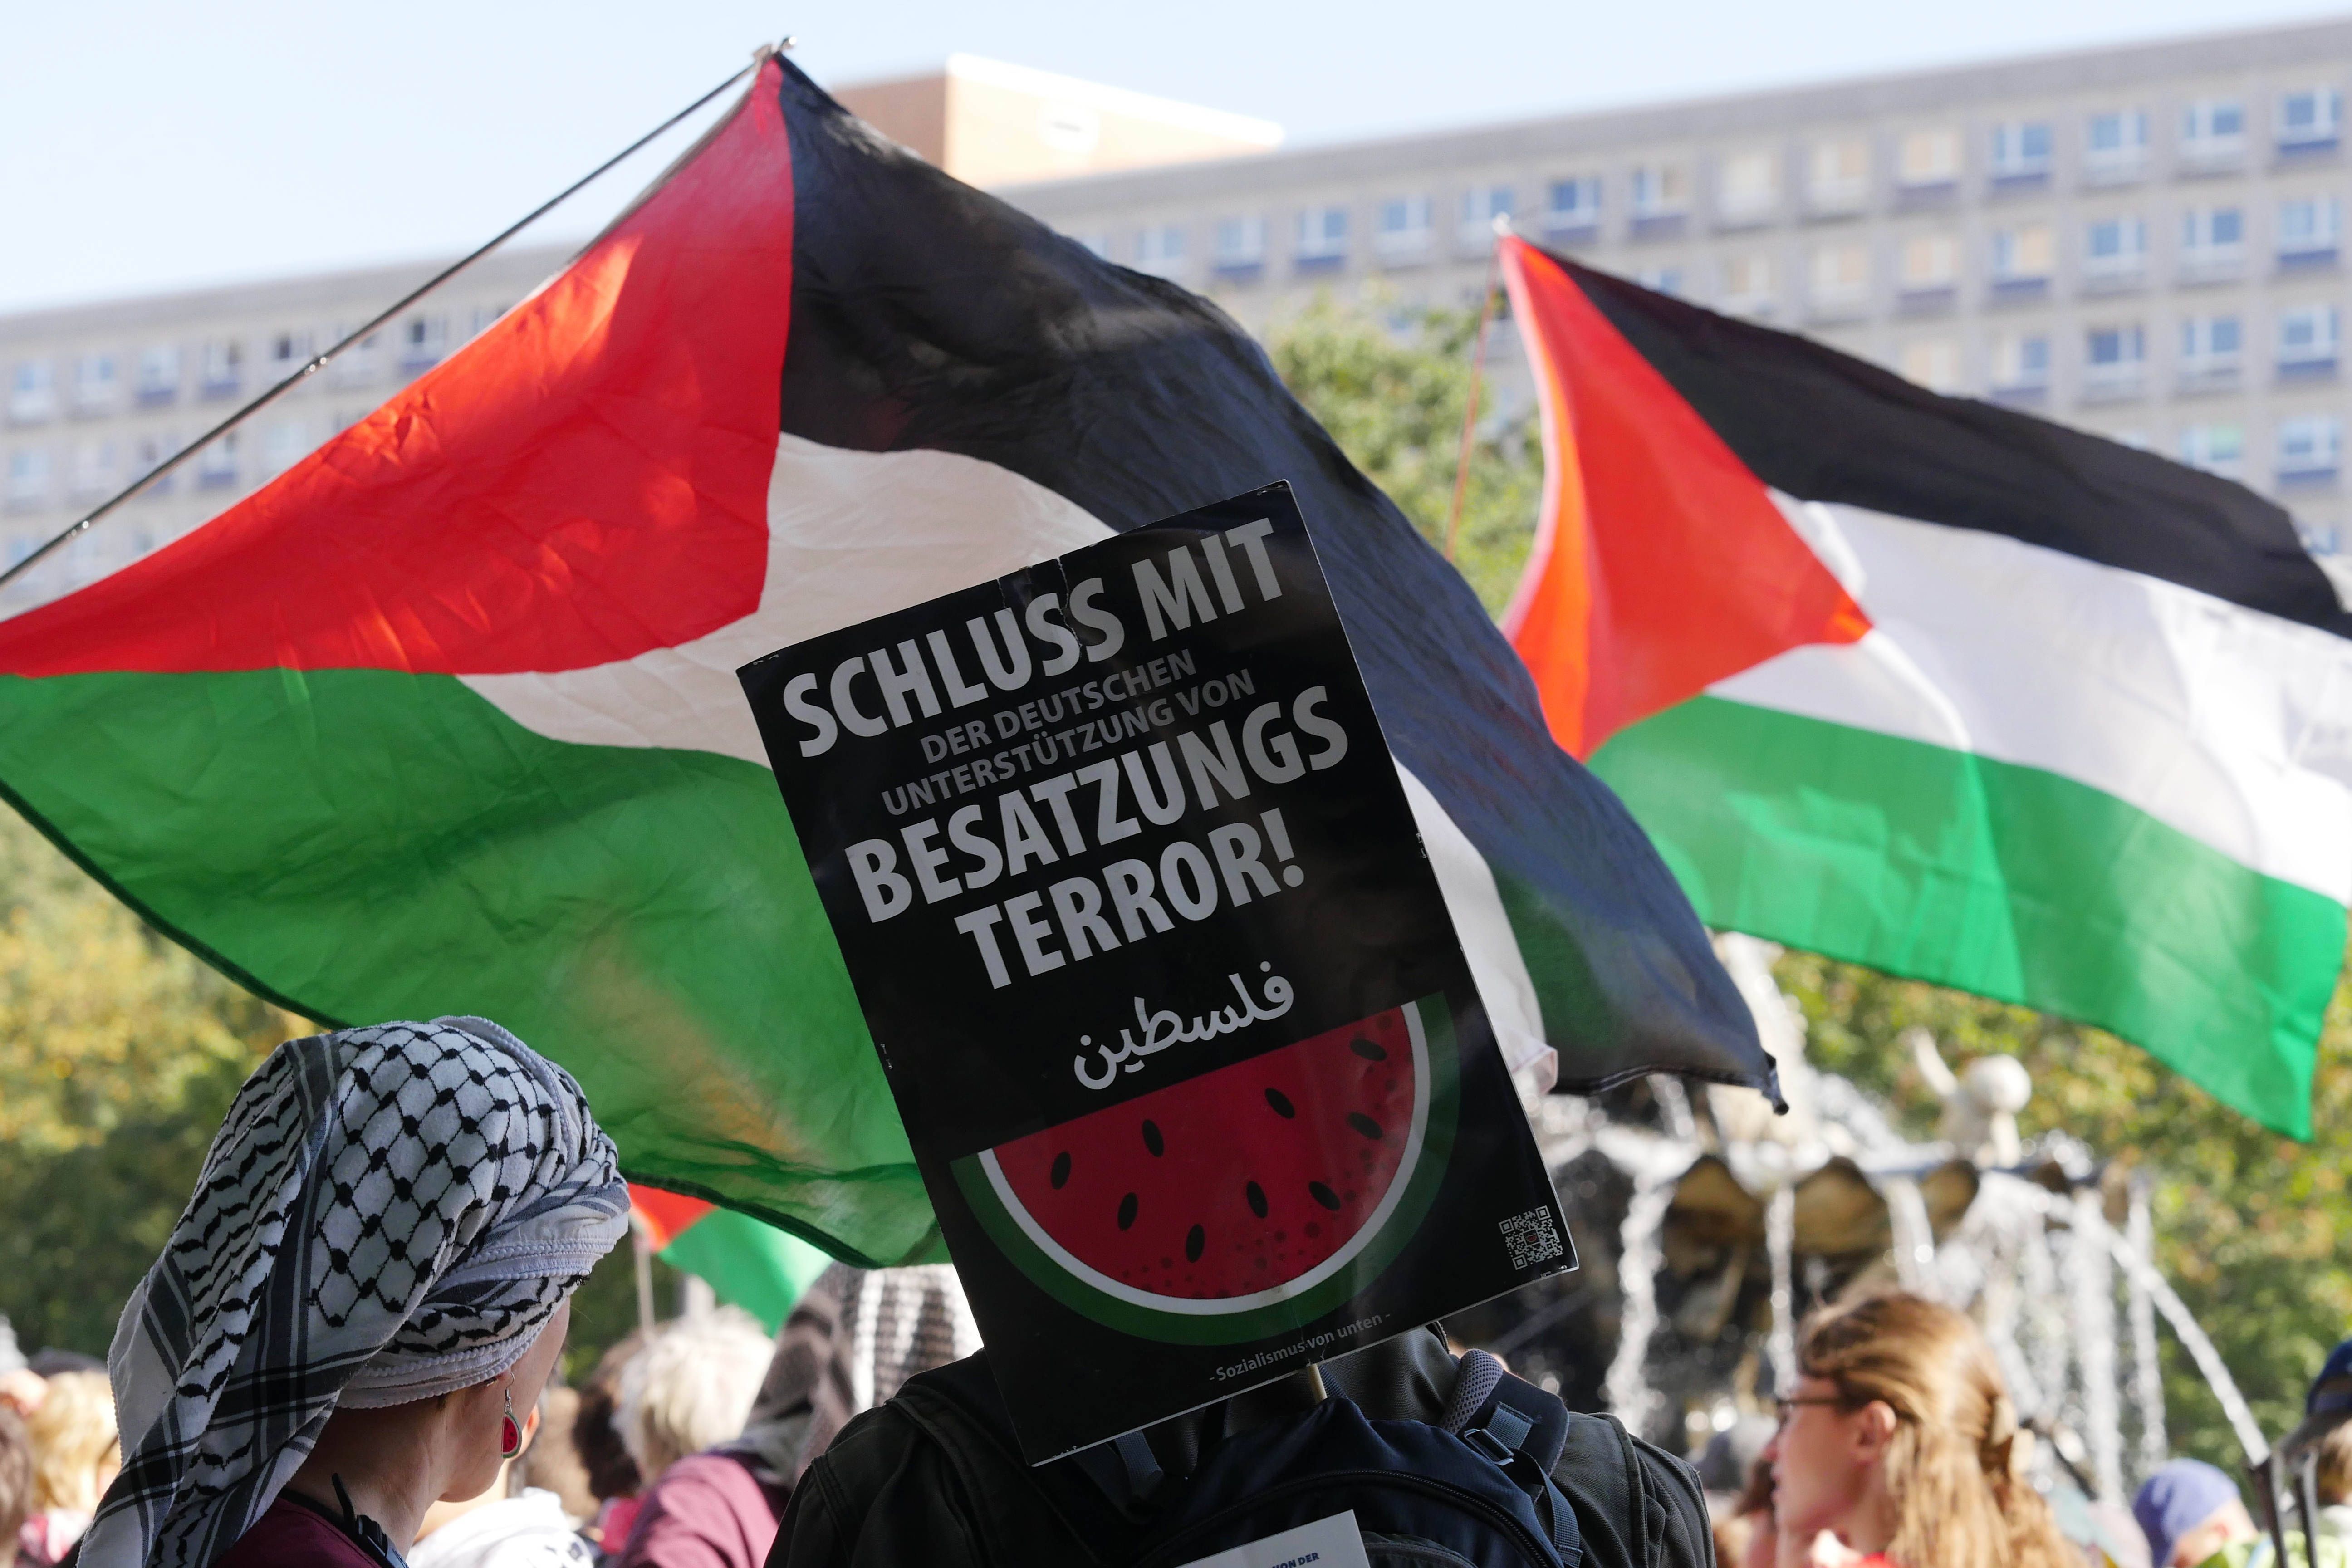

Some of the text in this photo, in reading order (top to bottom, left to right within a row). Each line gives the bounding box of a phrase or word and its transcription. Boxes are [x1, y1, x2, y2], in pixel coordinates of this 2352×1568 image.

[784, 518, 1282, 757] SCHLUSS MIT
[882, 669, 1255, 815] UNTERSTÜTZUNG VON
[920, 650, 1196, 763] DER DEUTSCHEN
[845, 686, 1348, 922] BESATZUNGS
[954, 808, 1303, 989] TERROR!
[1074, 961, 1294, 1089] فلسطين
[1215, 1341, 1305, 1381] Sozialismus
[1307, 1331, 1334, 1349] von
[1337, 1314, 1382, 1338] unten
[1298, 1553, 1319, 1565] DER
